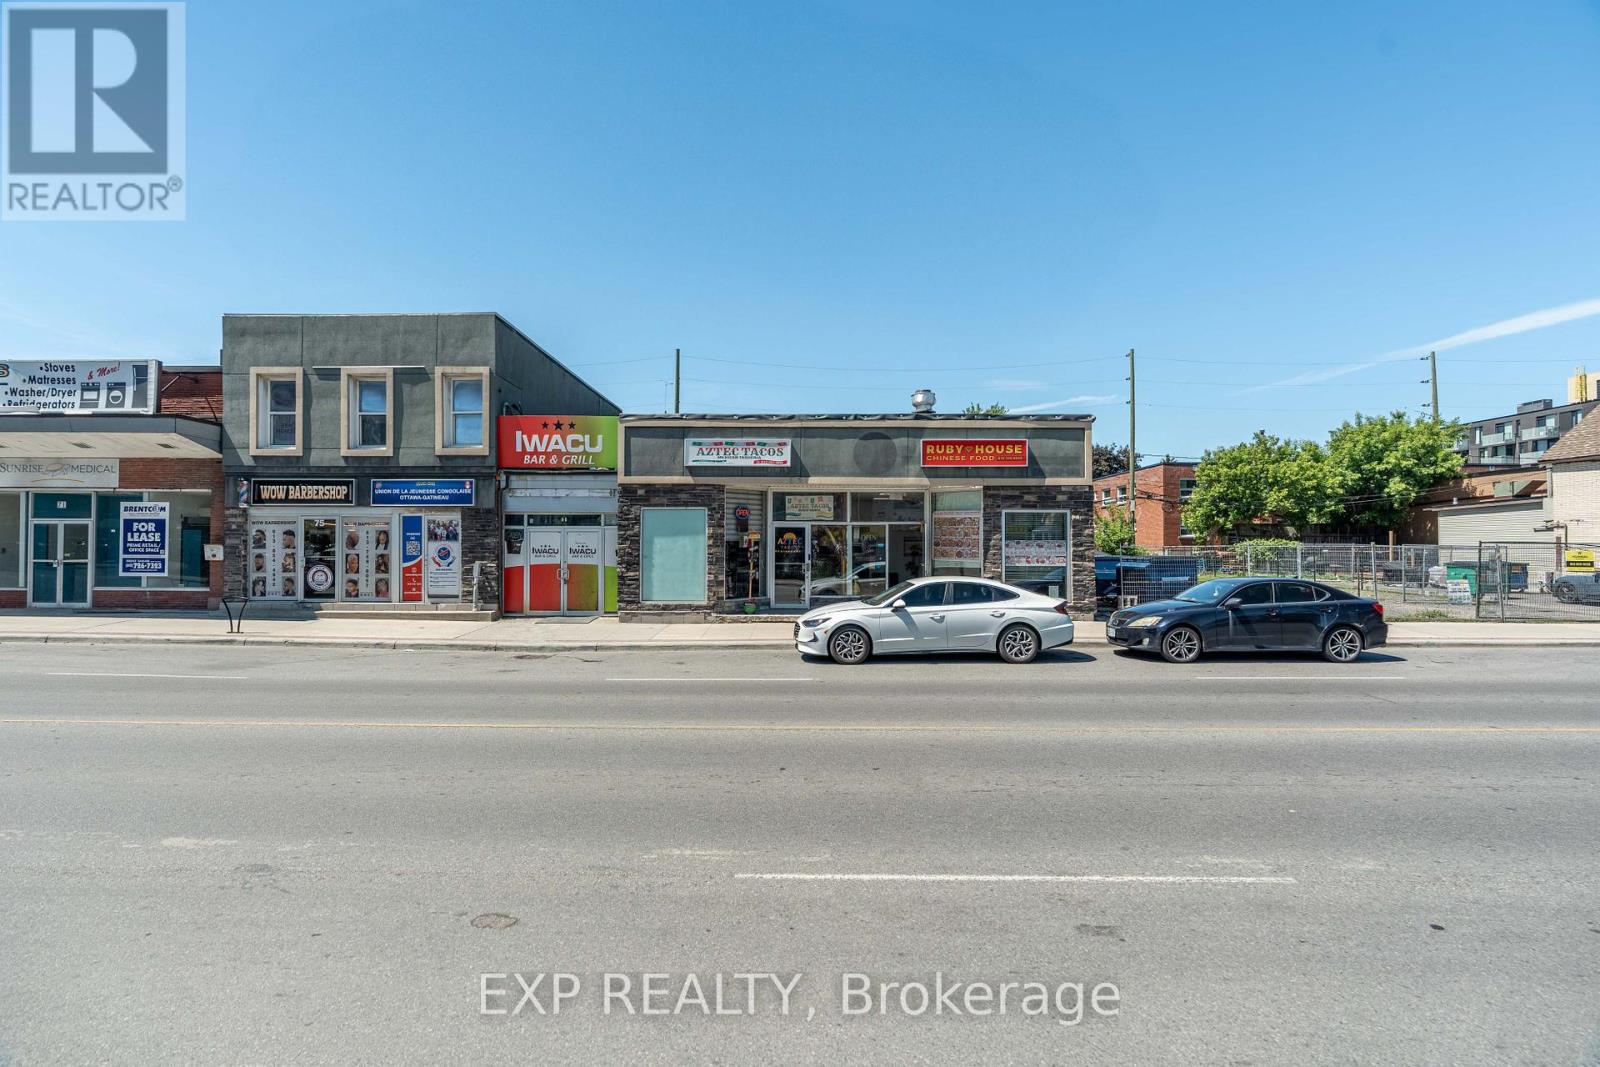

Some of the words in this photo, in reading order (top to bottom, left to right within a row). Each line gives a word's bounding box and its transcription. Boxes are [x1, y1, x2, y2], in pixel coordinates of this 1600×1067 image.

[44, 362, 76, 373] Stoves
[96, 361, 121, 377] More!
[27, 375, 77, 385] Matresses
[9, 387, 77, 398] Washer/Dryer
[696, 447, 739, 457] AZTEC
[740, 447, 784, 457] TACOS
[926, 444, 964, 454] RUBY
[975, 444, 1023, 454] HOUSE
[523, 455, 546, 465] BAR
[549, 455, 558, 465] &
[562, 455, 595, 465] GRILL
[0, 463, 44, 473] SUNRISE
[70, 464, 116, 474] MEDICAL
[260, 485, 287, 500] WOW
[288, 485, 348, 500] BARBERSHOP
[132, 522, 156, 532] FOR
[314, 519, 325, 527] 75
[127, 532, 161, 542] LEASE
